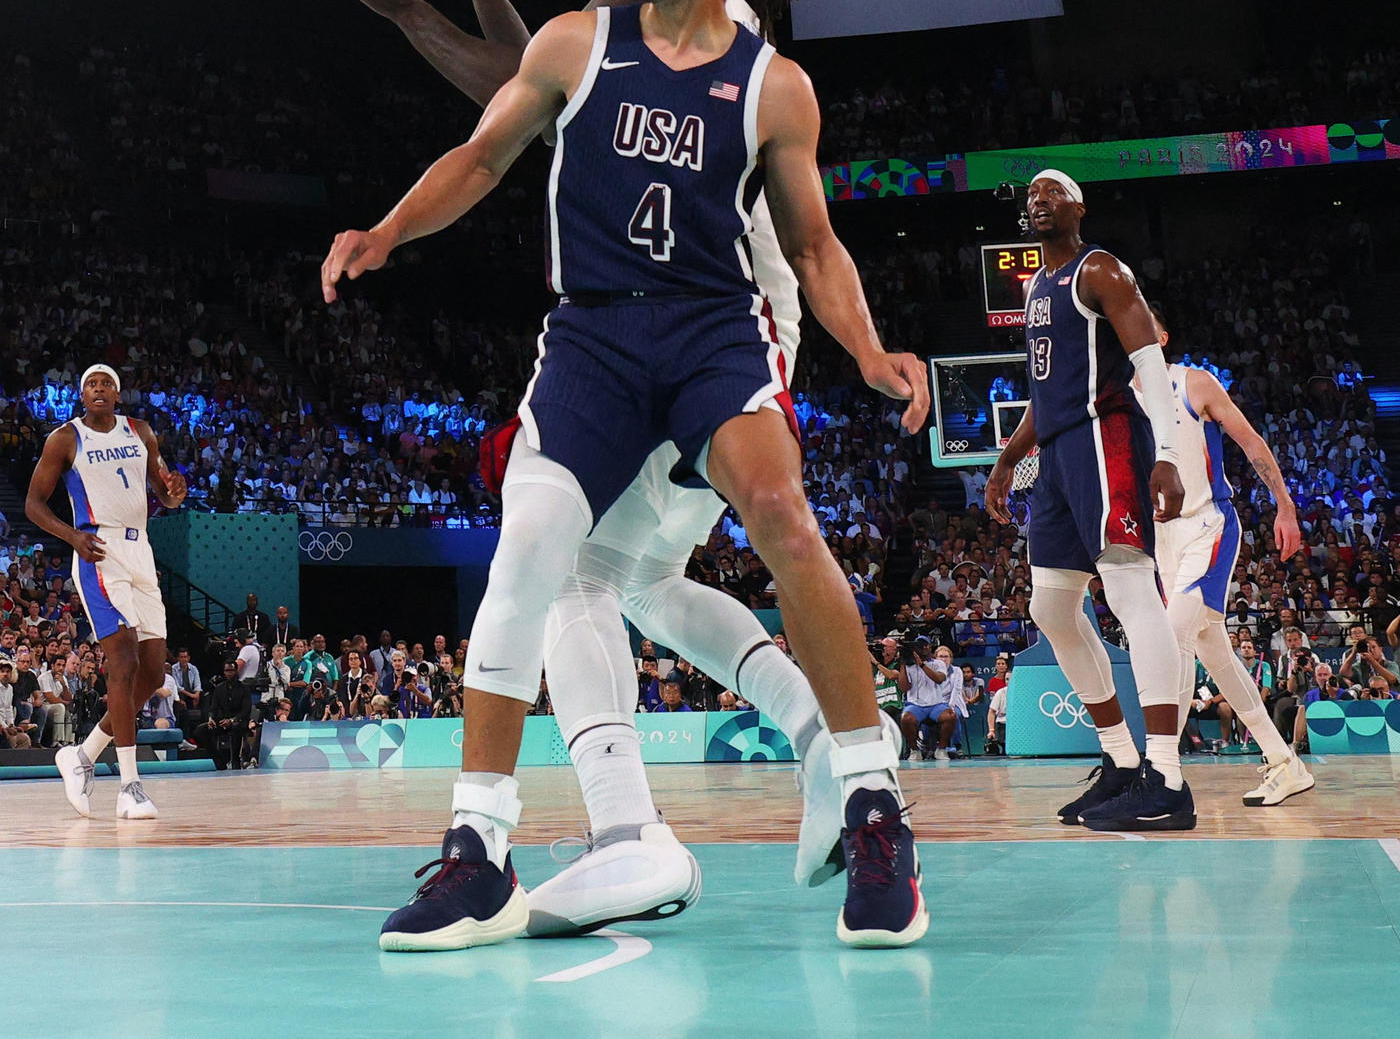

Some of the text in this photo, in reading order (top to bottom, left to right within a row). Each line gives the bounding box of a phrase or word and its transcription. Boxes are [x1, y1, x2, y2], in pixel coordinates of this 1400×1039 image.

[613, 102, 705, 171] USA
[1216, 138, 1293, 164] 2024
[628, 183, 675, 261] 4
[998, 250, 1040, 270] 2:13
[1004, 314, 1027, 325] OME
[86, 445, 142, 464] FRANCE
[116, 467, 130, 490] 1
[637, 730, 692, 745] 2024
